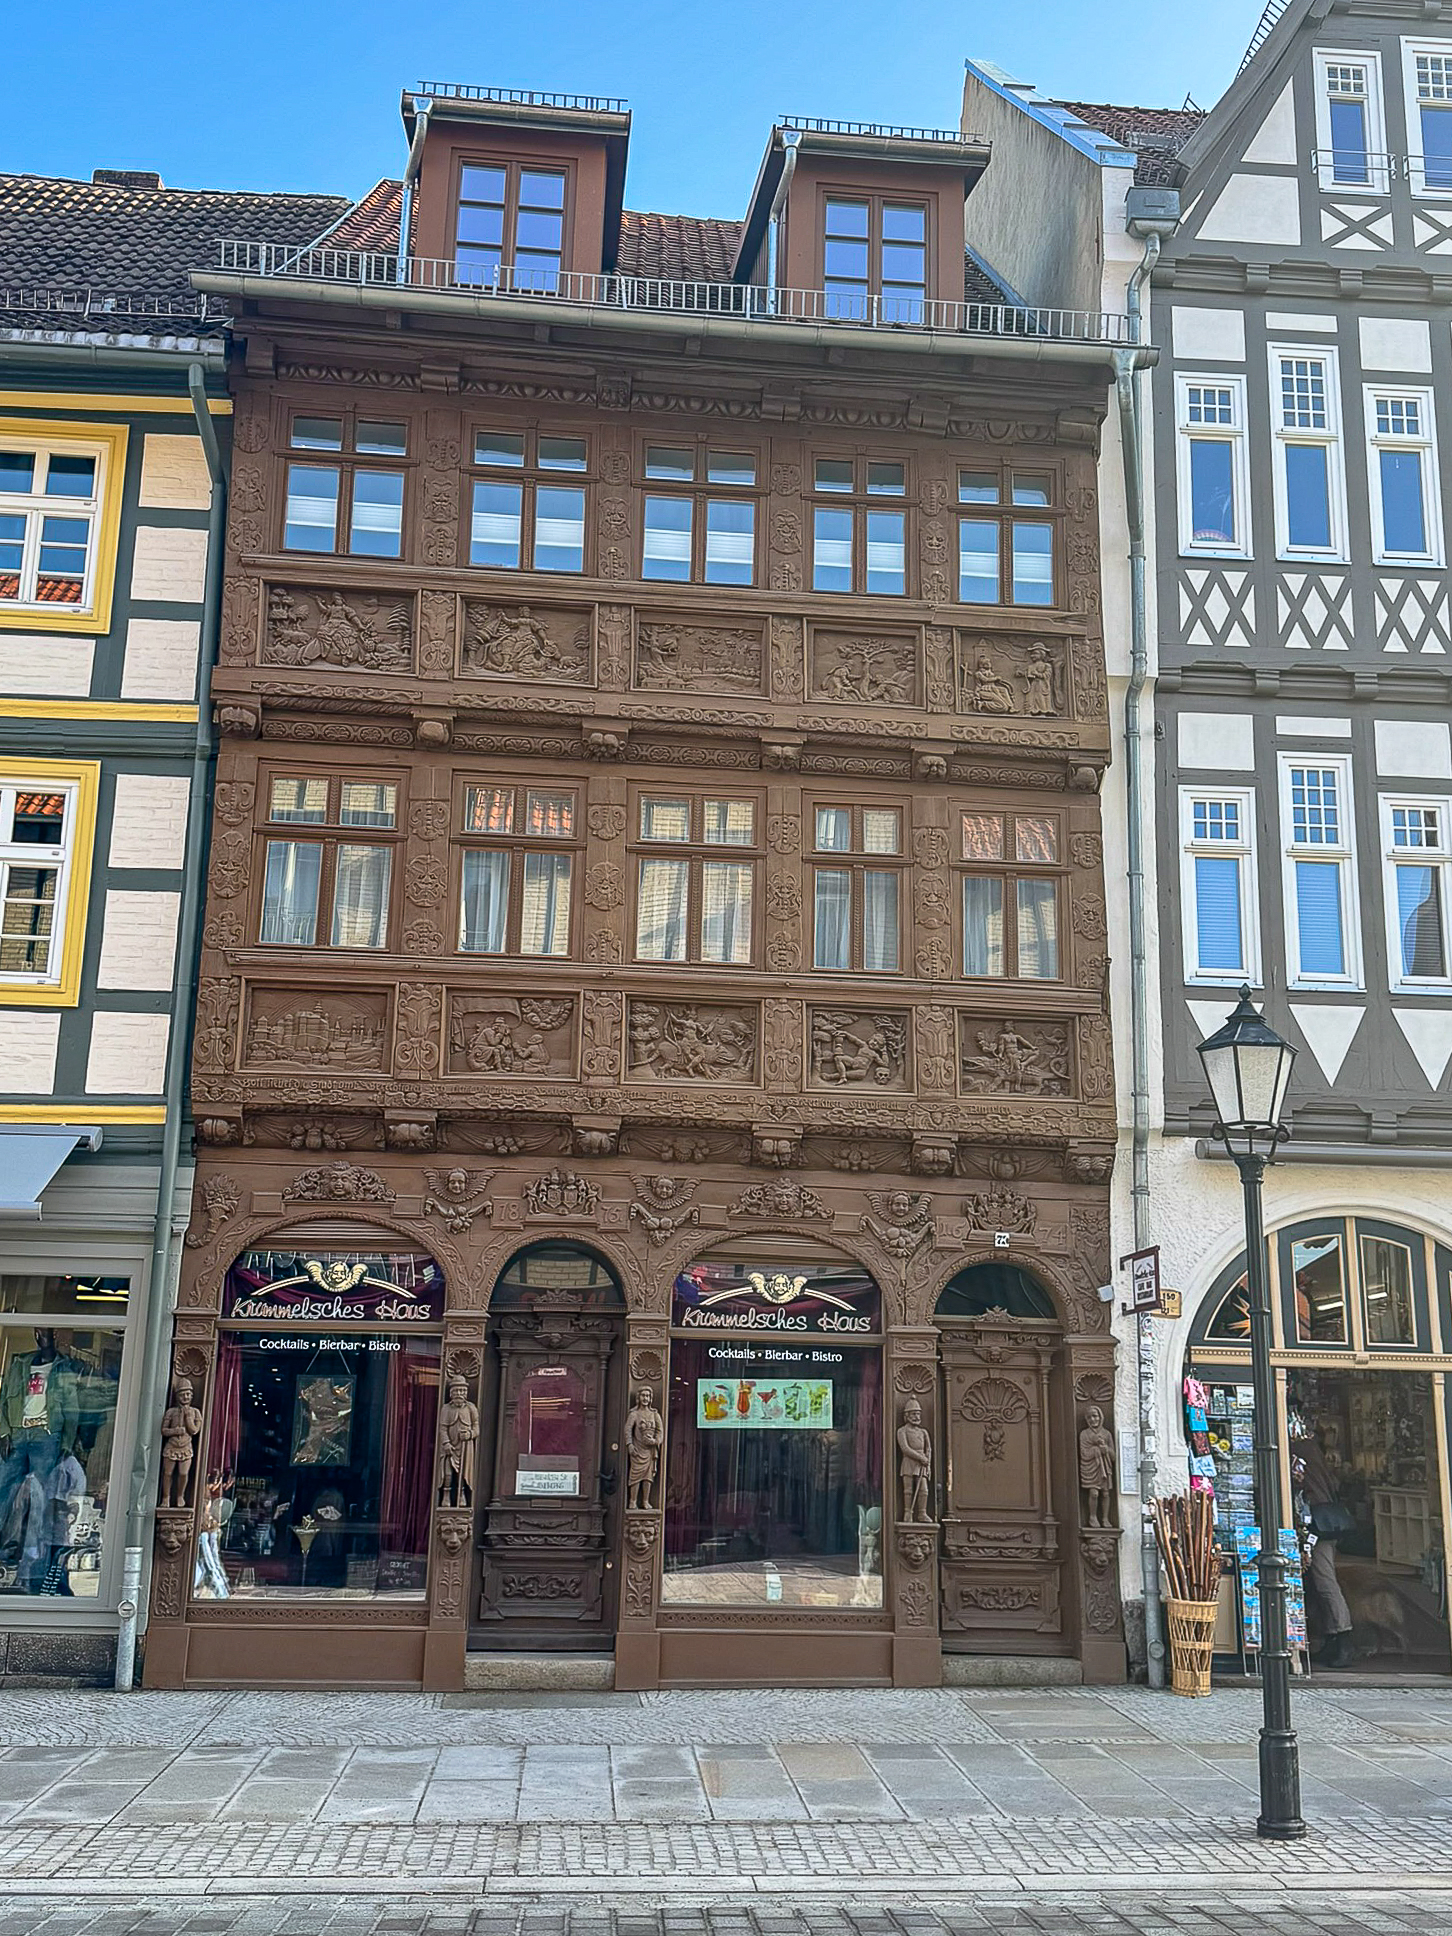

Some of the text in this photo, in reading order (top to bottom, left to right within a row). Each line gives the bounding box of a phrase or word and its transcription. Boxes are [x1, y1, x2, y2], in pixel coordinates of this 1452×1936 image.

[230, 1296, 431, 1320] Krummelsches Haus
[682, 1307, 872, 1332] Krummelsches Haus
[259, 1338, 401, 1351] Cocktails Bierbar Bistro
[708, 1347, 843, 1362] Cocktails Bierbar Bistro
